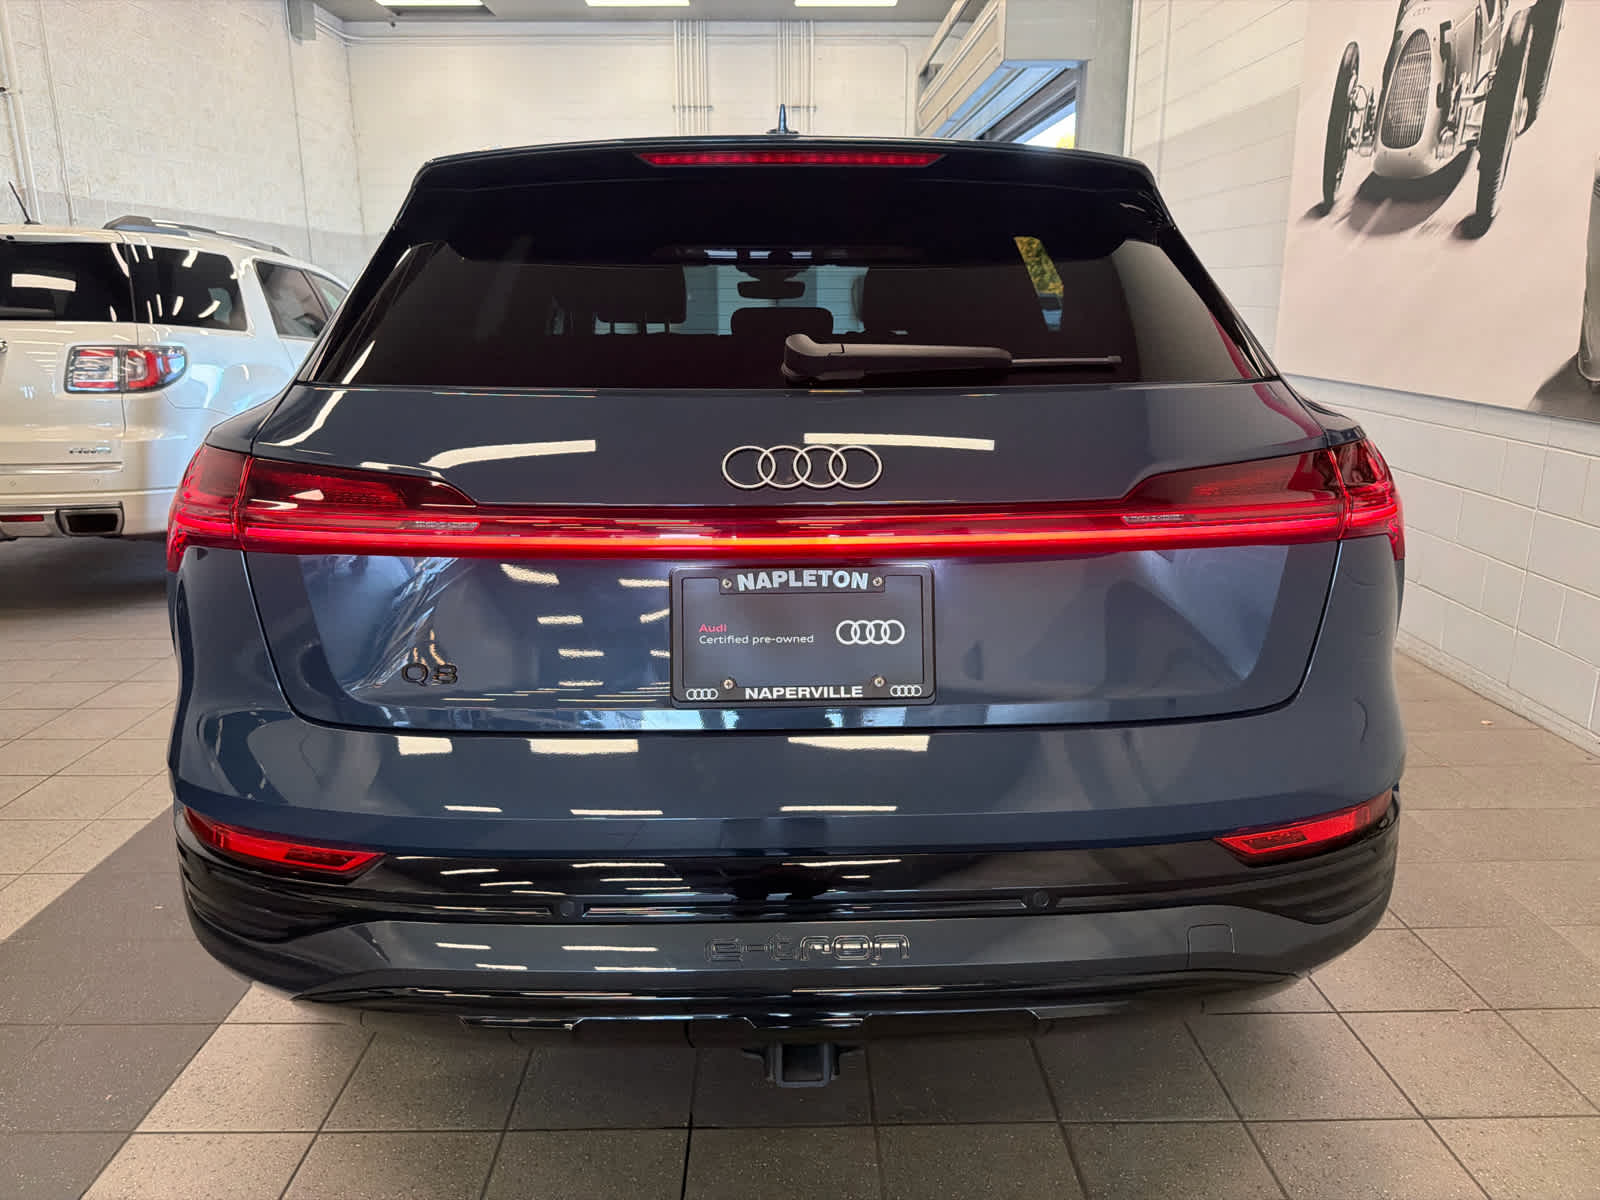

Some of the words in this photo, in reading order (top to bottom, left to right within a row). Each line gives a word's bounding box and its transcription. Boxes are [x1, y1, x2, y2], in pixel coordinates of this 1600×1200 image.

[736, 570, 869, 592] NAPLETON
[699, 623, 727, 633] Audi
[699, 635, 749, 644] Certified
[752, 635, 814, 646] pre-owned
[401, 663, 458, 687] Q8
[745, 686, 864, 700] NAPERVILLE
[705, 934, 911, 962] e-tron
